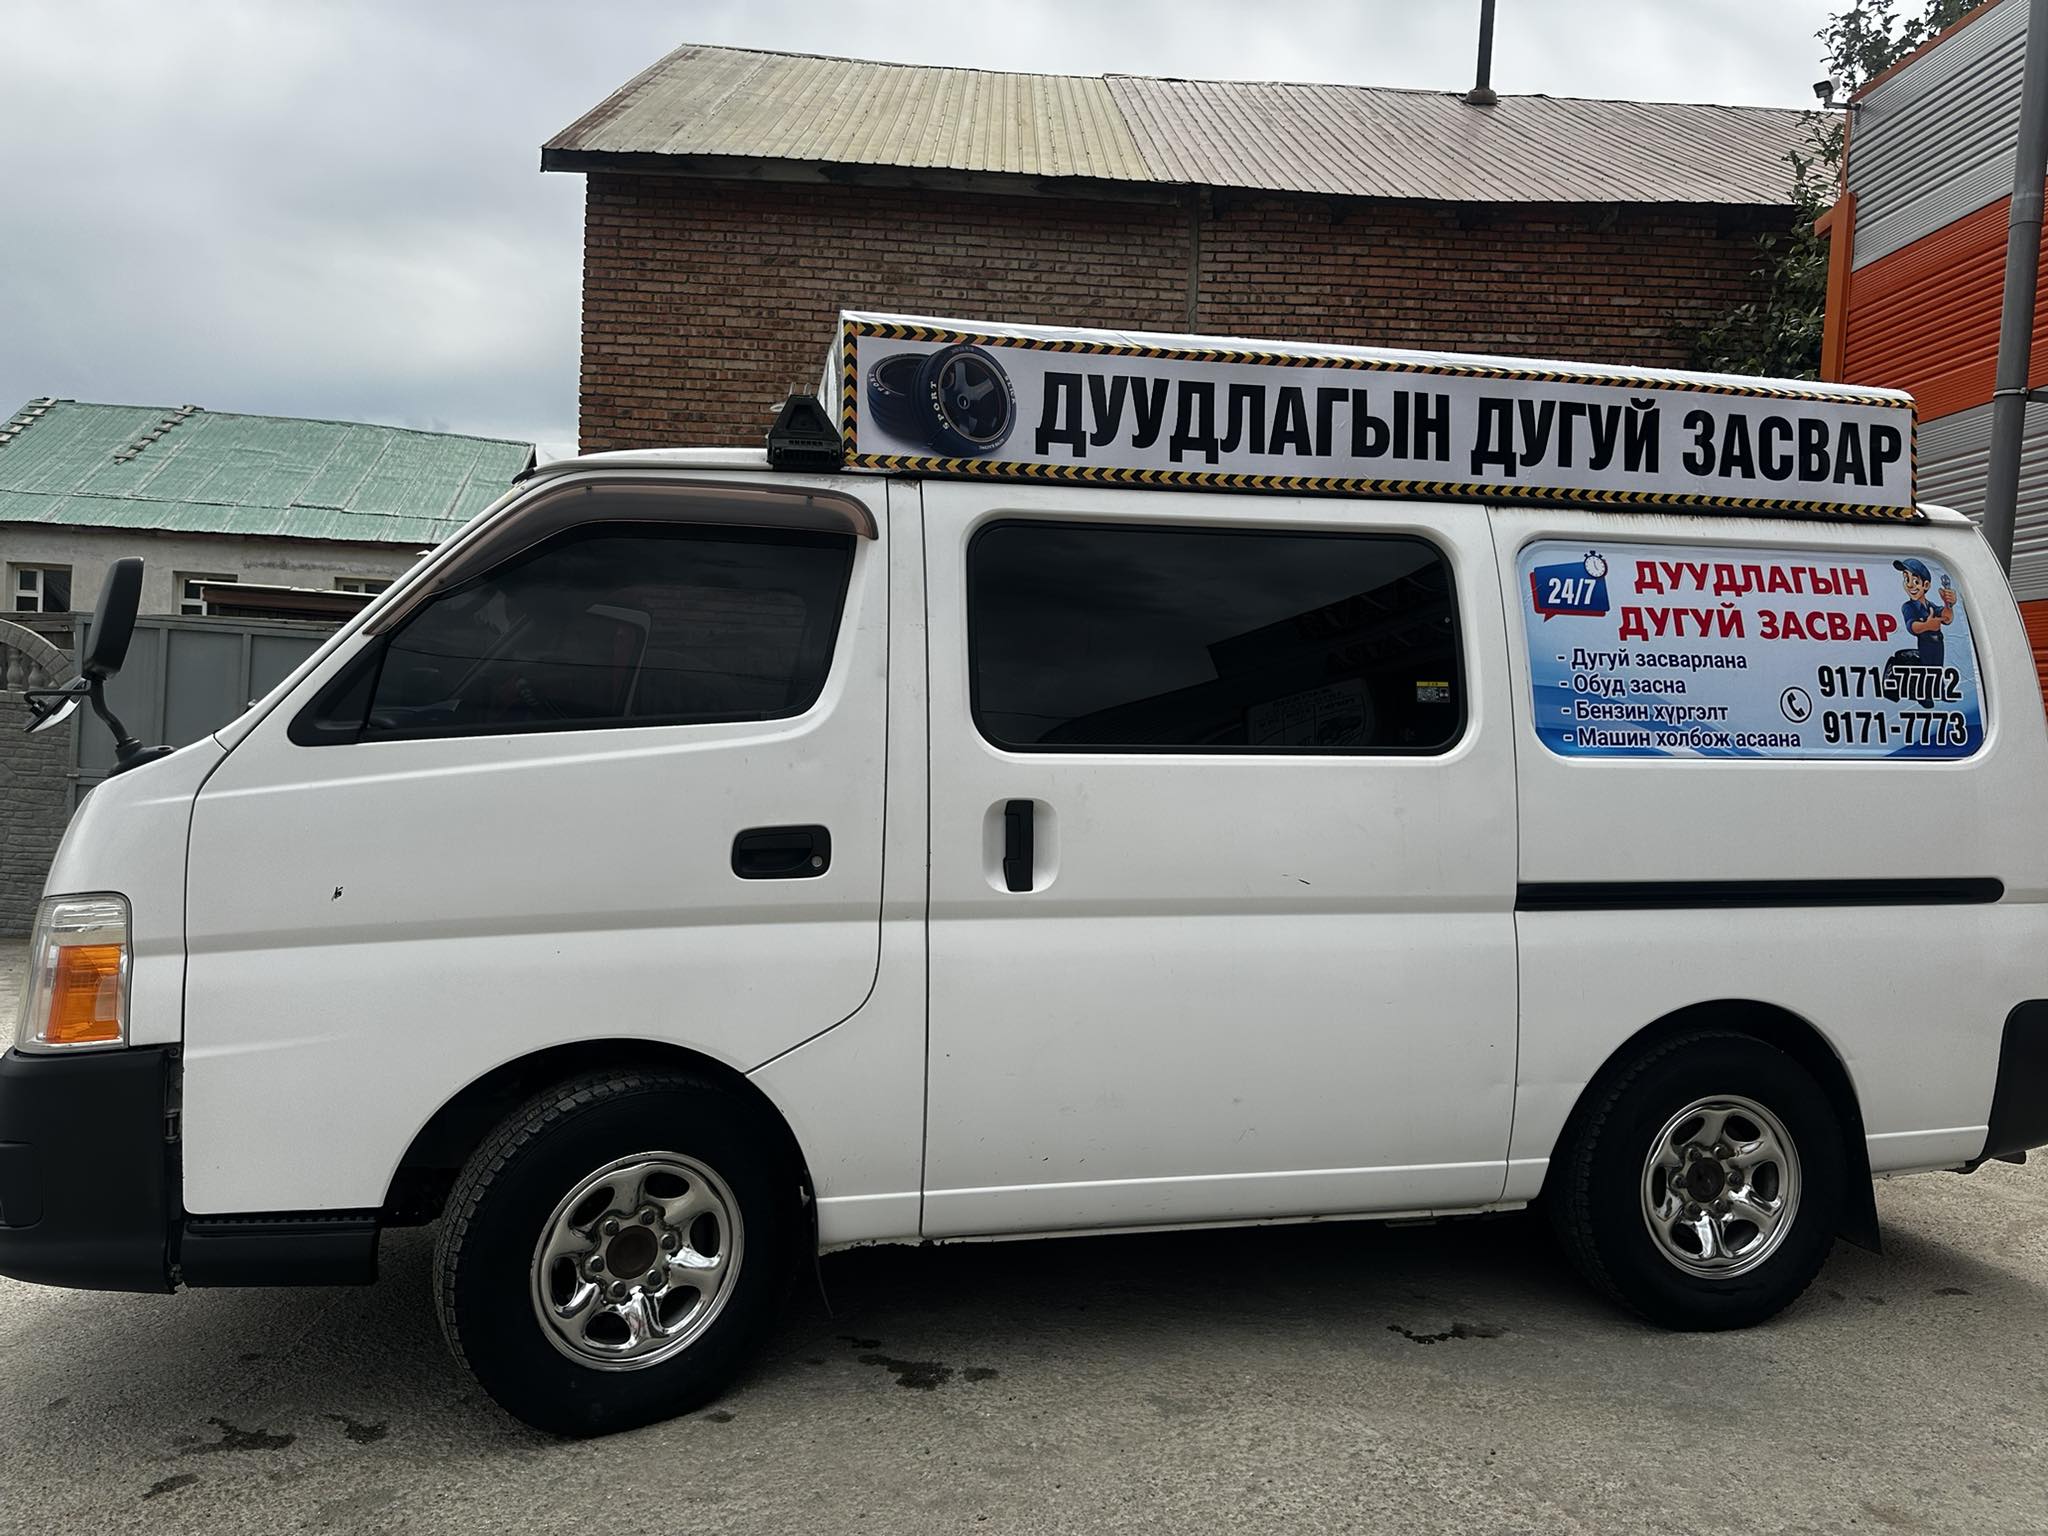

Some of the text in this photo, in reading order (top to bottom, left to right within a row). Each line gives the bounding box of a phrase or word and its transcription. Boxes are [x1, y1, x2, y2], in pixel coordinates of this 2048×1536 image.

[930, 381, 949, 430] SPORT
[1035, 371, 1900, 486] ДУУДЛАГЫН ДУГУЙ ЗАСВАР
[1548, 577, 1596, 605] 24/7
[1634, 561, 1869, 597] ДУУДЛАГЫН
[1618, 602, 1897, 641] ДУГУЙ ЗАСВАР
[1571, 648, 1630, 671] Дугуй
[1635, 653, 1748, 672] засварлана
[1574, 674, 1626, 697] Обуд
[1630, 679, 1687, 694] засна
[1818, 665, 1962, 699] 9171-7772
[1576, 701, 1649, 720] Бензин
[1654, 706, 1728, 724] хүргэлт
[1823, 711, 1967, 745] 9171-7773
[1578, 728, 1651, 747] Машин
[1656, 727, 1731, 747] холбож
[1736, 733, 1801, 747] асаана
